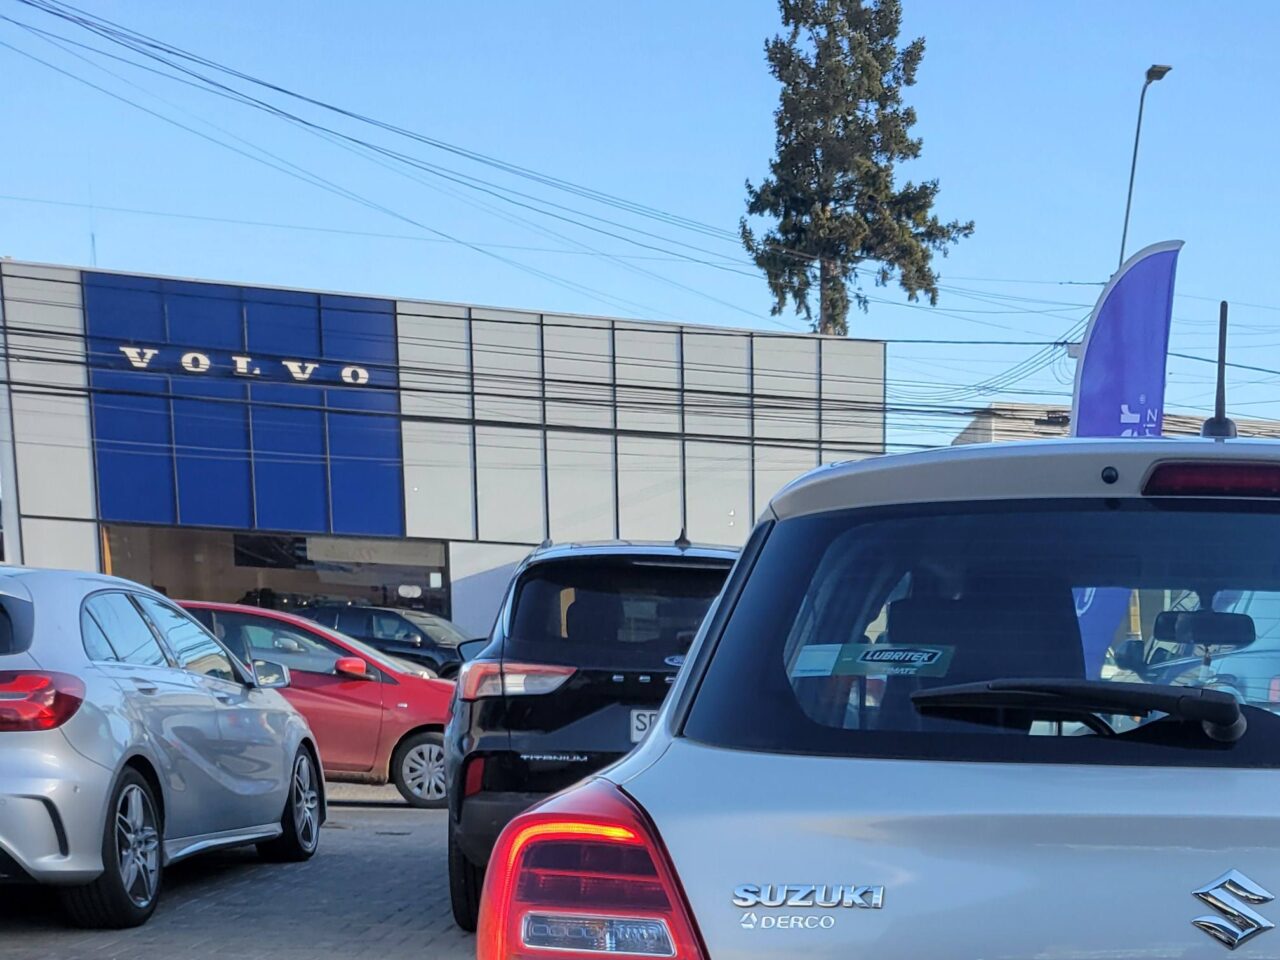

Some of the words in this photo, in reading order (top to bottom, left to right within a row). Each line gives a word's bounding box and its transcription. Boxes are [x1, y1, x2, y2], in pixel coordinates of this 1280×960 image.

[119, 346, 369, 384] VOLVO
[865, 651, 933, 661] LUBRITEK
[520, 754, 588, 762] TITANIUM
[732, 884, 884, 908] SUZUKI
[760, 915, 834, 929] DERCO
